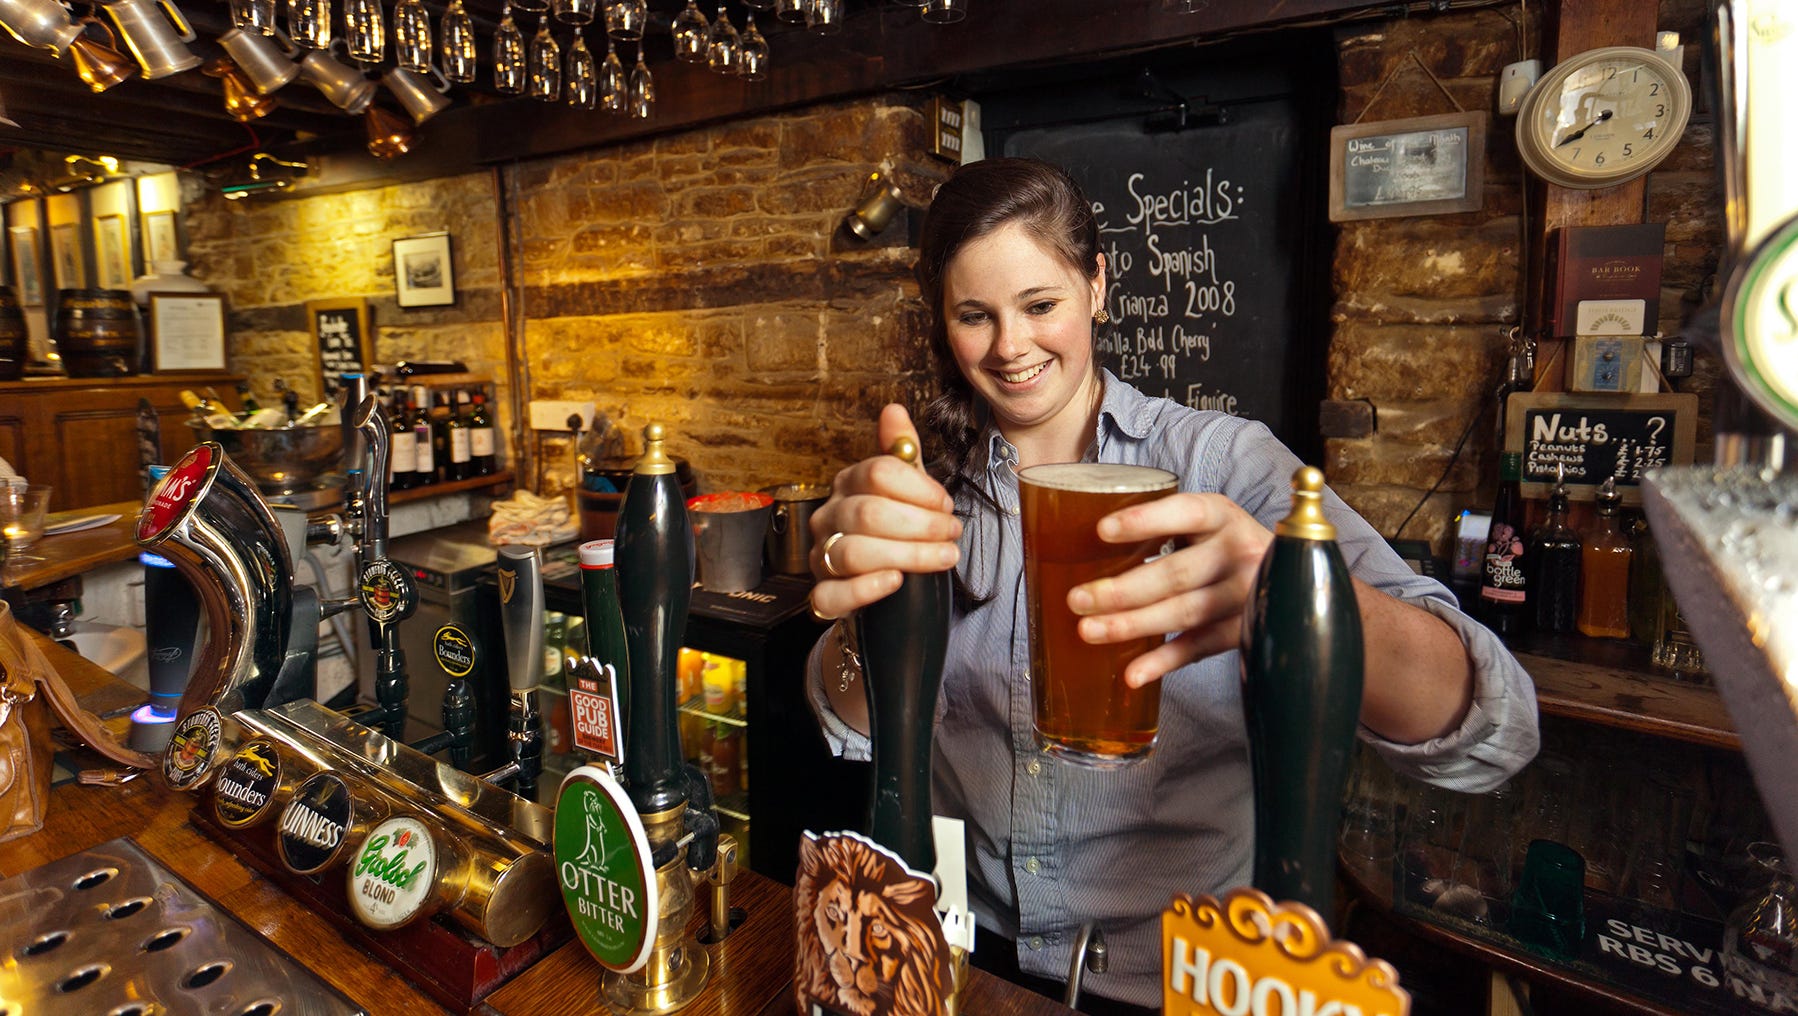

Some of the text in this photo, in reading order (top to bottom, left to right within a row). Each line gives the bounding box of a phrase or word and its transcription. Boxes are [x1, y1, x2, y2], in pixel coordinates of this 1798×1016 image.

[1649, 83, 1659, 97] 2
[1655, 104, 1665, 117] 3
[1642, 127, 1654, 140] 4
[1571, 147, 1581, 160] 7
[1623, 143, 1633, 157] 5
[1595, 151, 1605, 165] 6
[1126, 167, 1245, 236] Specials:
[1147, 233, 1217, 291] Spanish
[1591, 264, 1642, 274] BAR BOOK
[1107, 280, 1236, 325] Crianza 2008
[1529, 440, 1586, 454] Peanuts
[1528, 451, 1585, 464] Cashews
[1528, 461, 1587, 476] Pistahios
[1486, 562, 1522, 577] bottle
[1493, 574, 1526, 588] green
[580, 679, 597, 692] THE
[574, 693, 607, 712] GOOD
[576, 704, 609, 729] PUB
[577, 721, 609, 740] GUIDE
[281, 800, 343, 848] UINNESS
[362, 878, 396, 905] BLOND
[561, 861, 639, 920] OTTER
[578, 896, 625, 934] BITTER
[1597, 932, 1683, 975] RBS
[1691, 965, 1720, 988] 6
